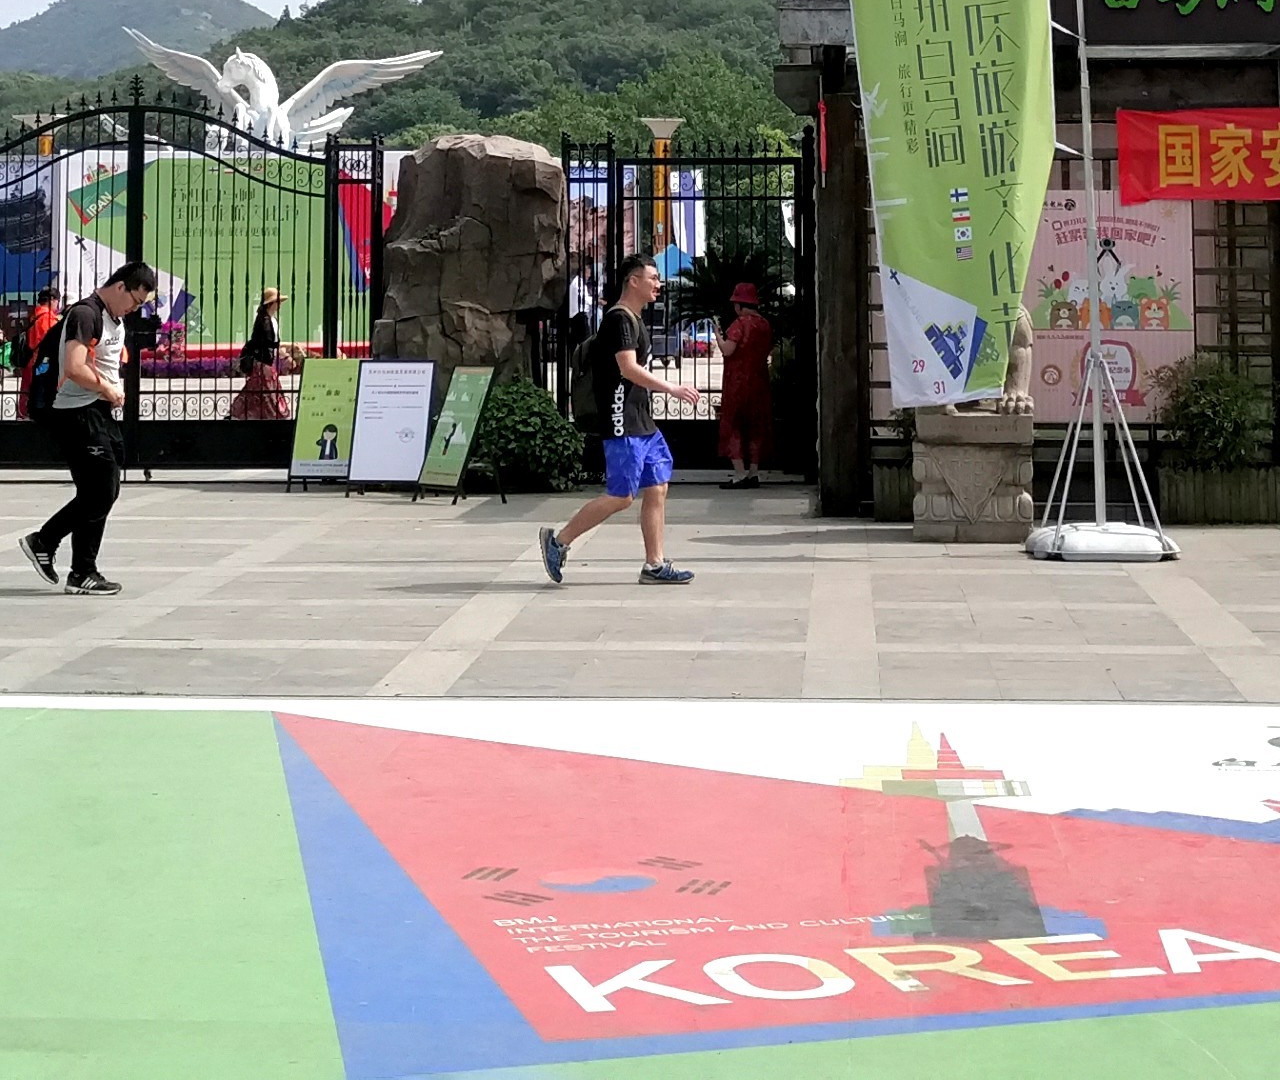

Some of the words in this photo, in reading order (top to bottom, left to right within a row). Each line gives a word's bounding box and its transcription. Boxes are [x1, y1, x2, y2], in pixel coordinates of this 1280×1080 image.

[85, 191, 112, 217] IRAN
[911, 359, 926, 374] 29
[933, 381, 946, 395] 31
[611, 382, 625, 437] adidas
[492, 915, 559, 927] BMJ
[505, 916, 734, 935] INTERNATIONAL
[512, 933, 573, 945] THE
[581, 926, 715, 940] TOURISM
[727, 922, 789, 932] AND
[799, 913, 927, 928] CULTURE
[525, 939, 667, 954] FESTIVAL
